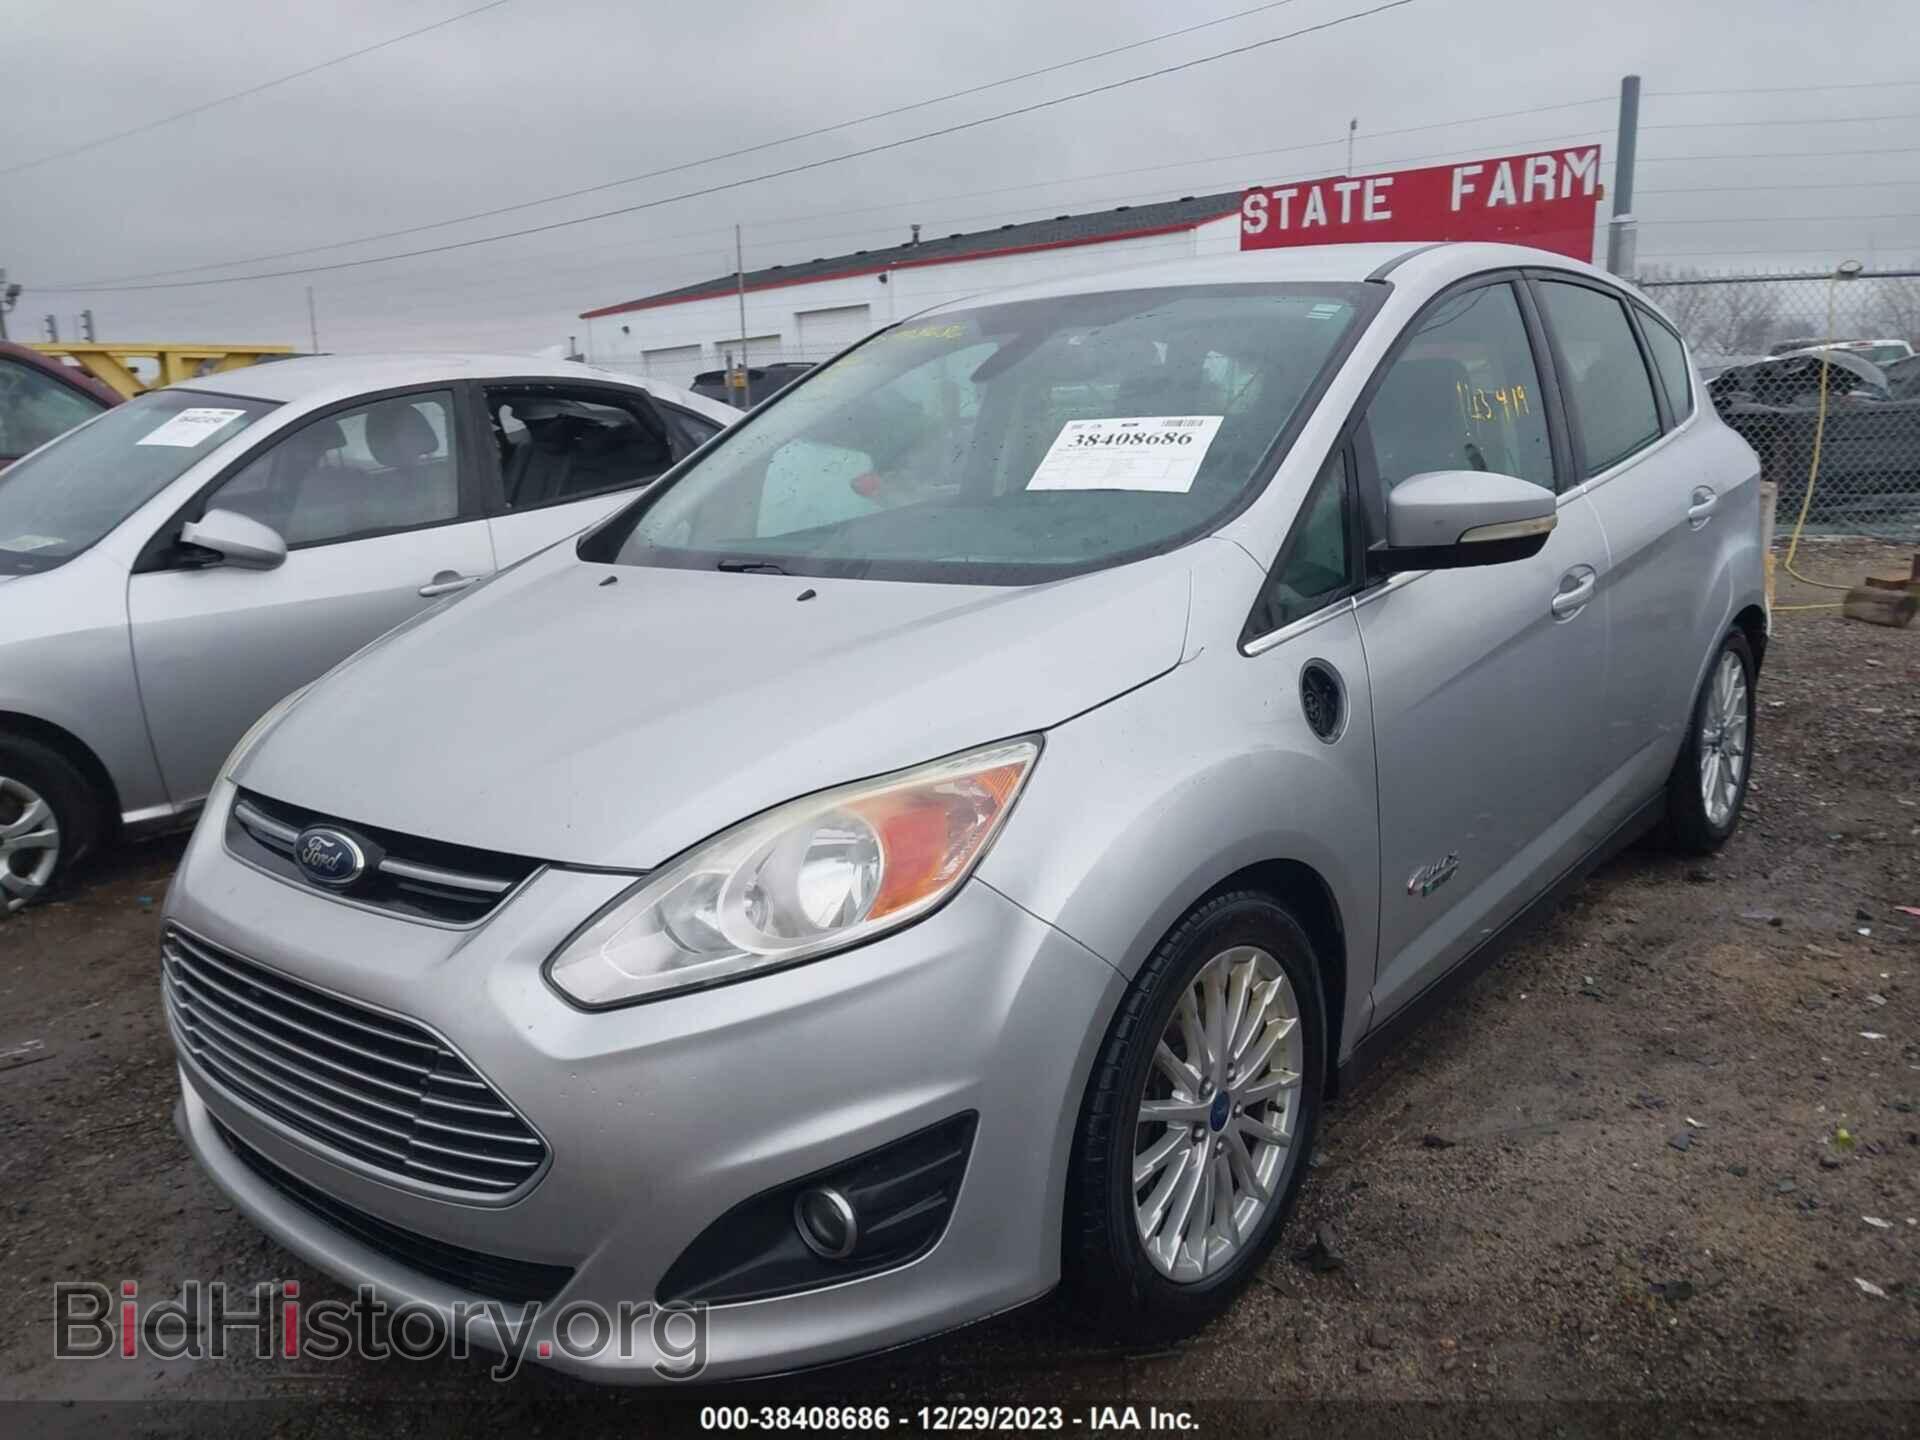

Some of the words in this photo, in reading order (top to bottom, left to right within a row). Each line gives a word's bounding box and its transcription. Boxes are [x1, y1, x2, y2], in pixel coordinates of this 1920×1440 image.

[1242, 176, 1394, 235] STATE
[1450, 148, 1598, 212] FARM
[1069, 431, 1194, 448] 38408686
